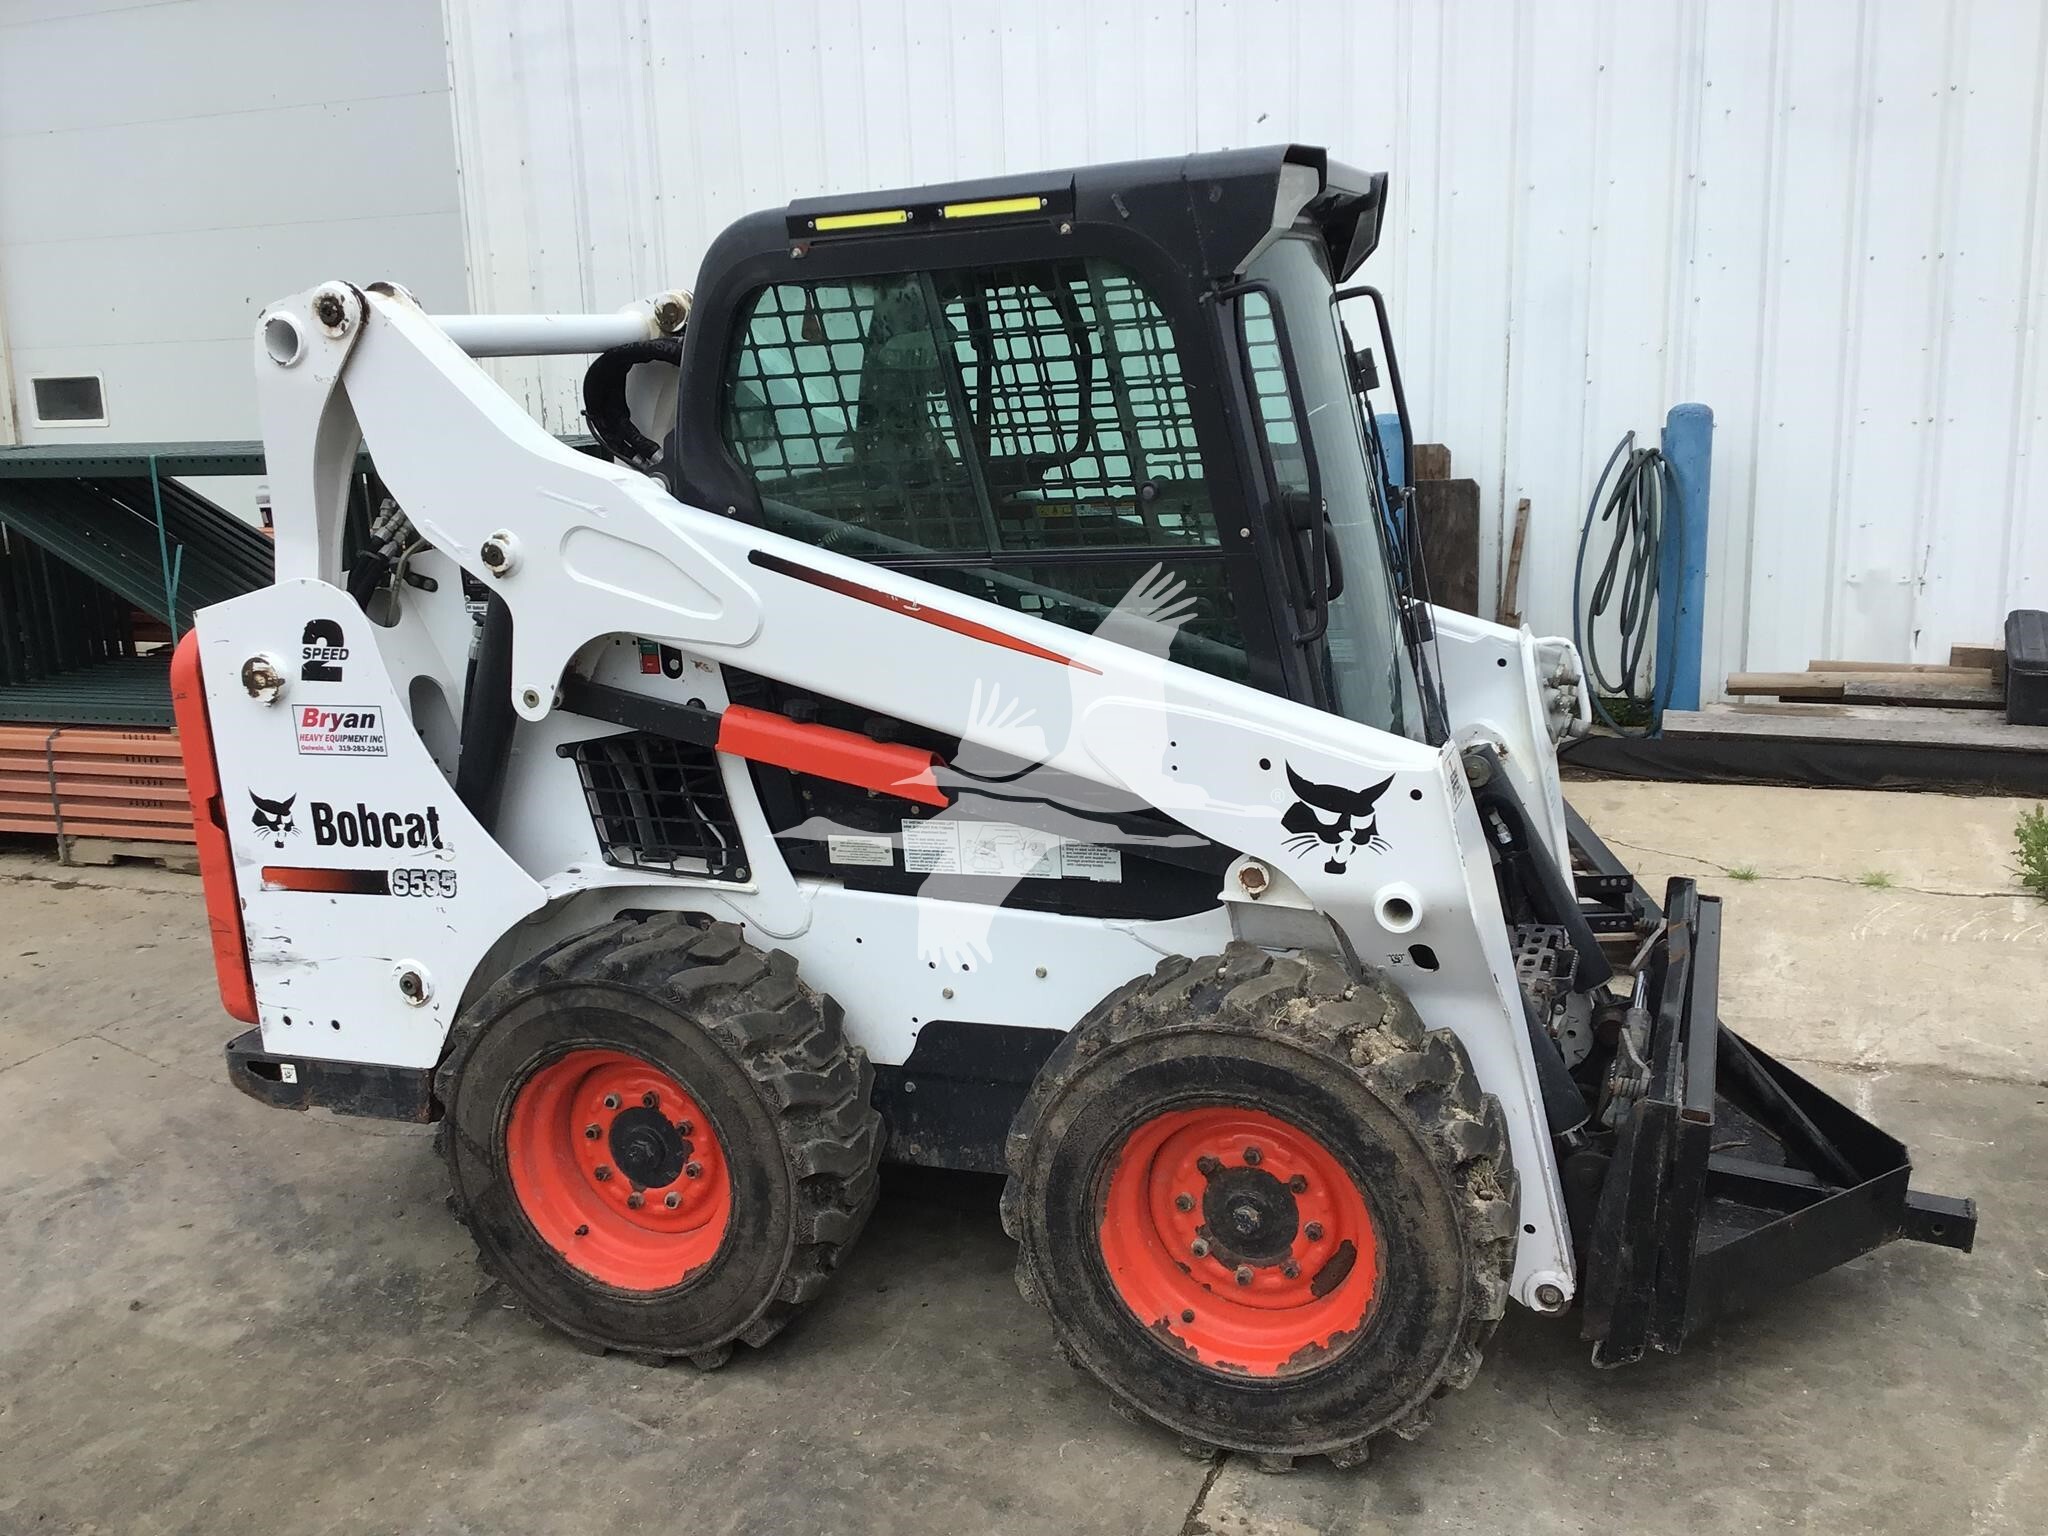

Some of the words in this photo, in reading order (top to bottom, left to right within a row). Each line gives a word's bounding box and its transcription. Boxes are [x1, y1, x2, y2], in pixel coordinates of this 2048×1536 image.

[301, 619, 345, 682] 2
[302, 647, 350, 660] SPEED
[302, 707, 376, 733] Bryan
[299, 734, 324, 742] HEAVY
[325, 734, 369, 744] EQUIPMENT
[370, 735, 384, 744] INC
[338, 745, 385, 753] 319-283-2345
[310, 802, 444, 849] Bobcat
[392, 868, 457, 898] S595
